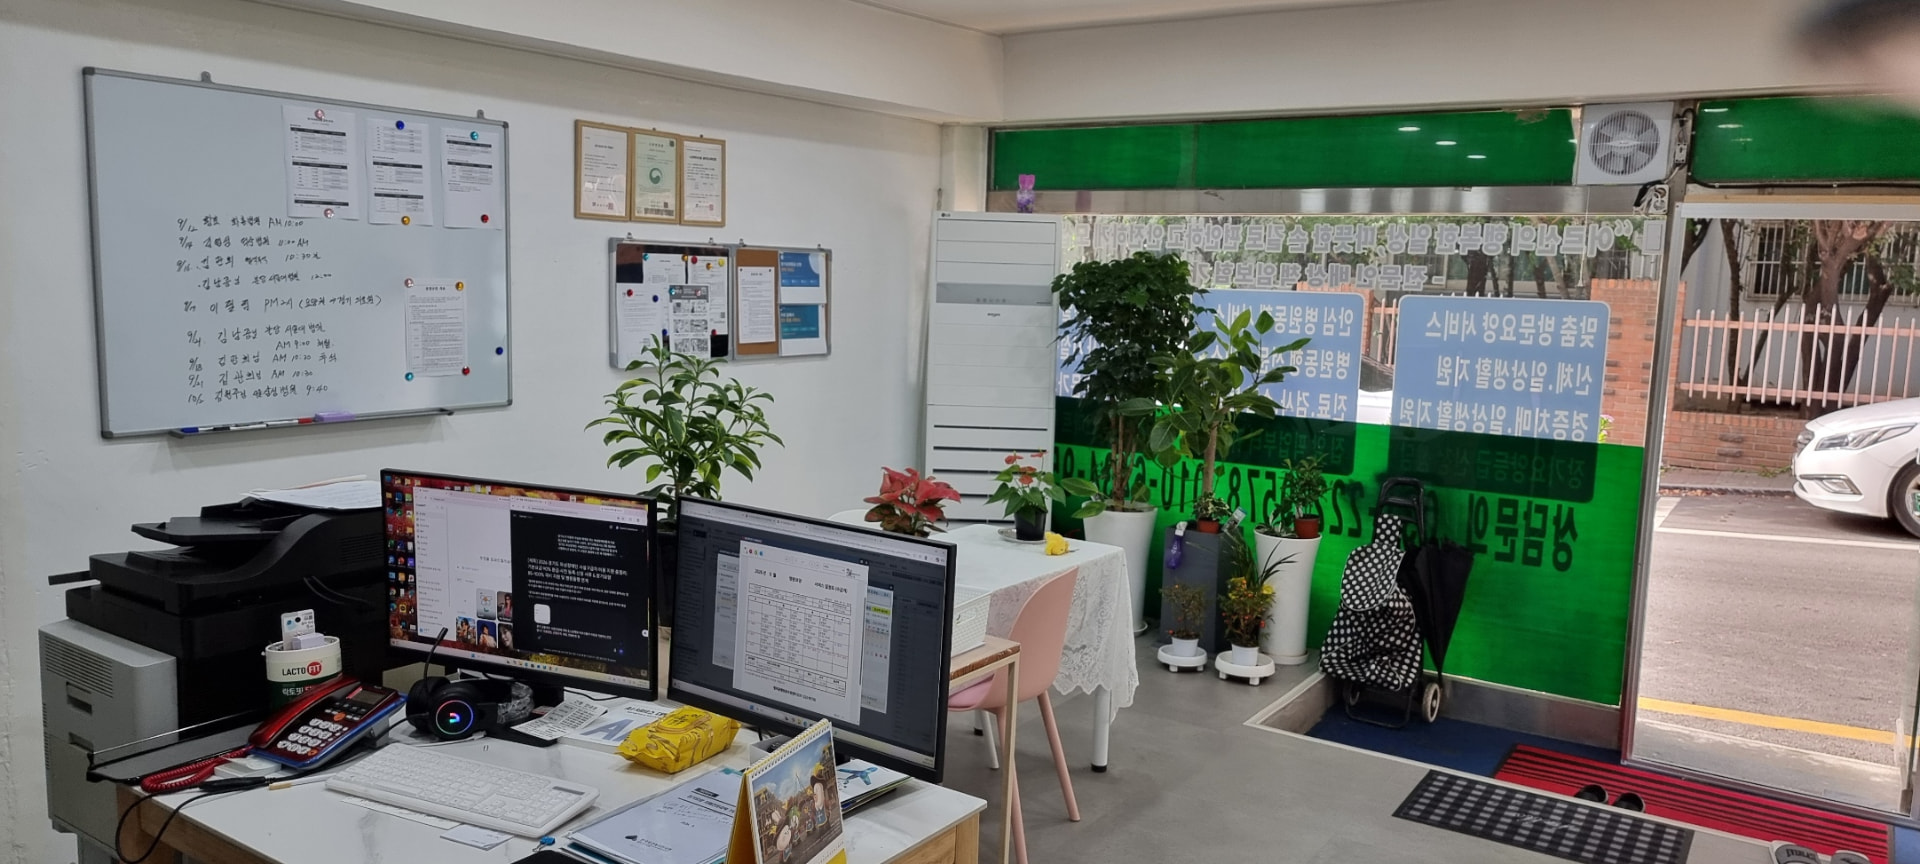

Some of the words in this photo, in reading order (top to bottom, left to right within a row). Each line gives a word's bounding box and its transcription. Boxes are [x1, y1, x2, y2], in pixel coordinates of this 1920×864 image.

[275, 340, 292, 351] AM
[273, 354, 287, 363] AM
[271, 371, 285, 379] AM
[306, 384, 328, 395] 9:40
[282, 667, 307, 677] LACTO
[308, 664, 322, 674] FIT
